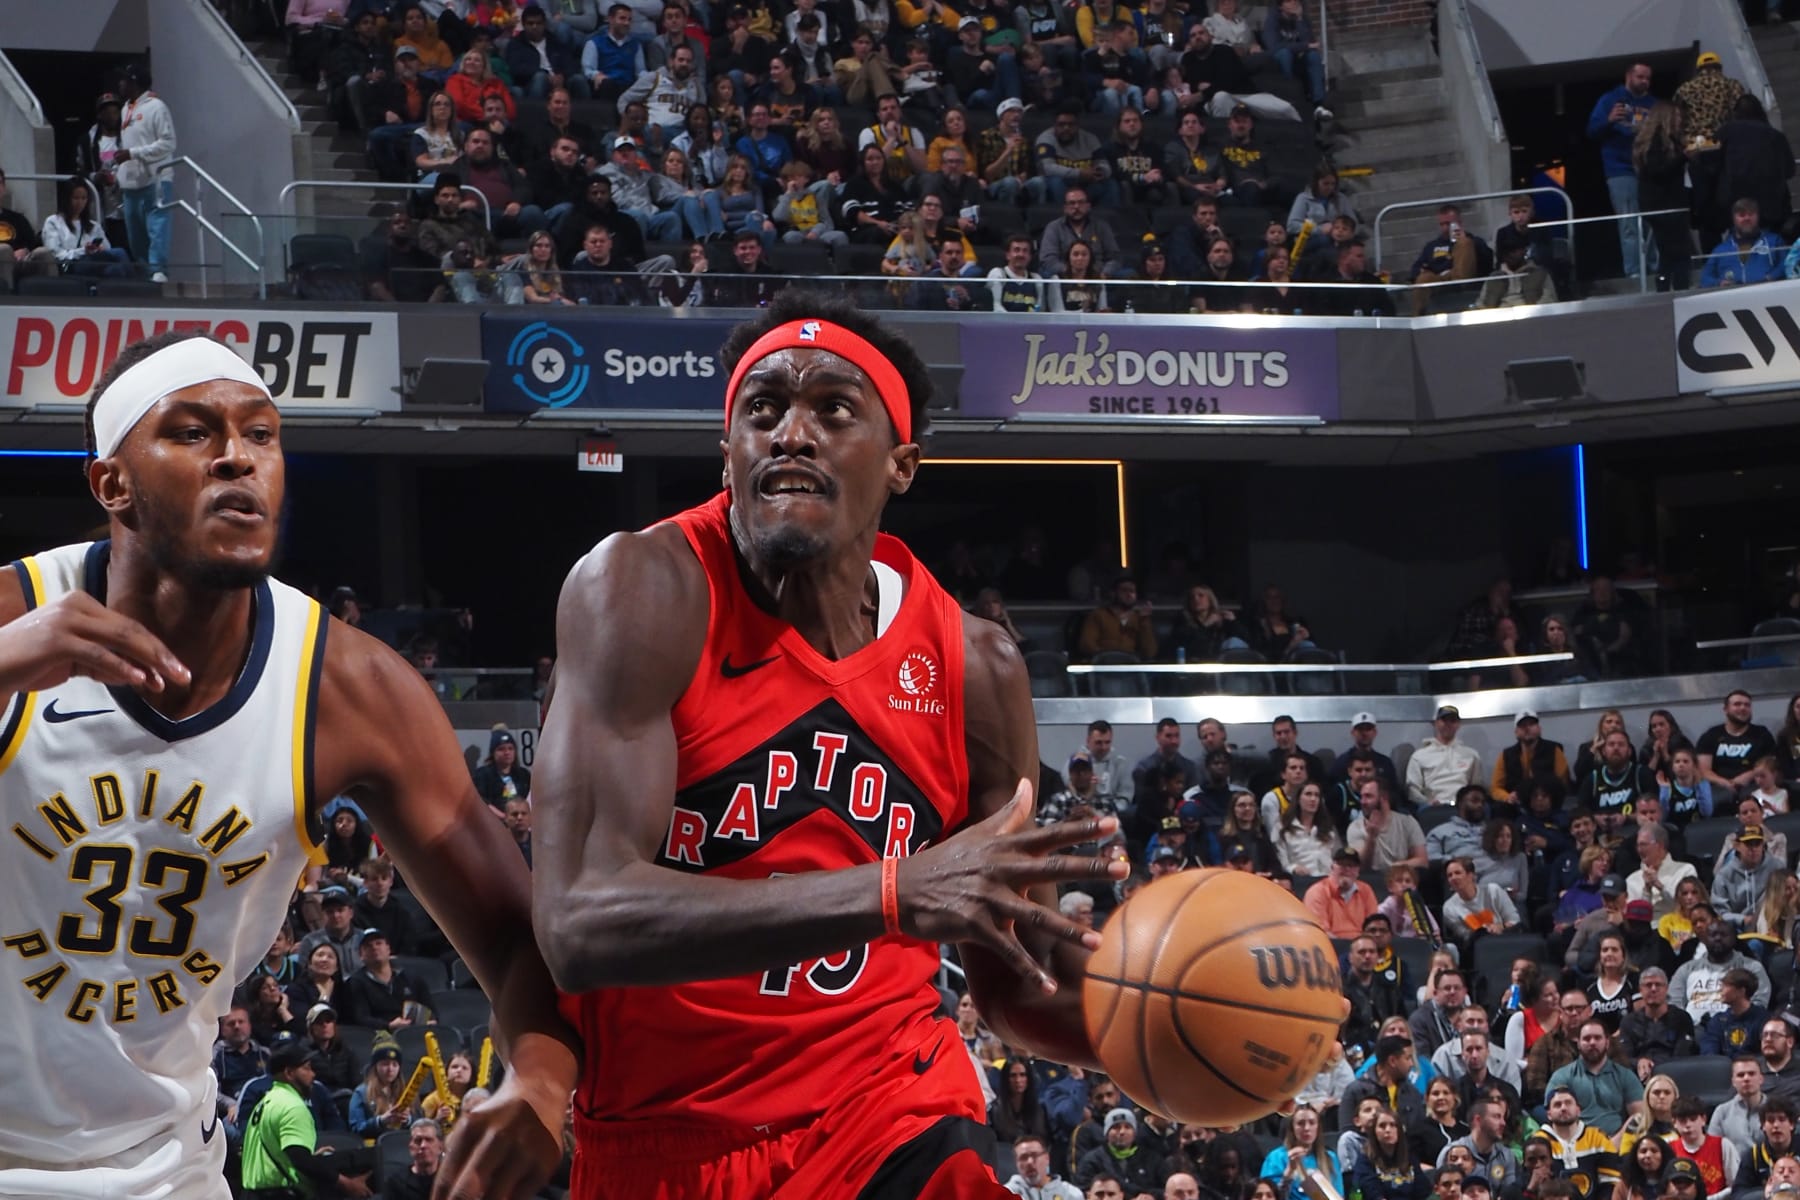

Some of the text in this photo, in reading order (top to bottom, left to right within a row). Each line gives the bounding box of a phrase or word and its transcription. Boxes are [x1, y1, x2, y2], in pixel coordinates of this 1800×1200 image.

[6, 317, 373, 398] POIBET
[604, 348, 716, 384] Sports
[1117, 350, 1289, 387] DONUTS
[1089, 396, 1221, 414] SINCE 1961
[585, 441, 616, 466] EXIT
[888, 694, 945, 715] Sun Life
[1716, 743, 1752, 757] INDY
[665, 731, 930, 867] RAPTOR
[1599, 788, 1632, 807] INDY
[12, 768, 272, 888] INDIANA
[56, 842, 209, 957] 33
[3, 928, 224, 1025] PACERS
